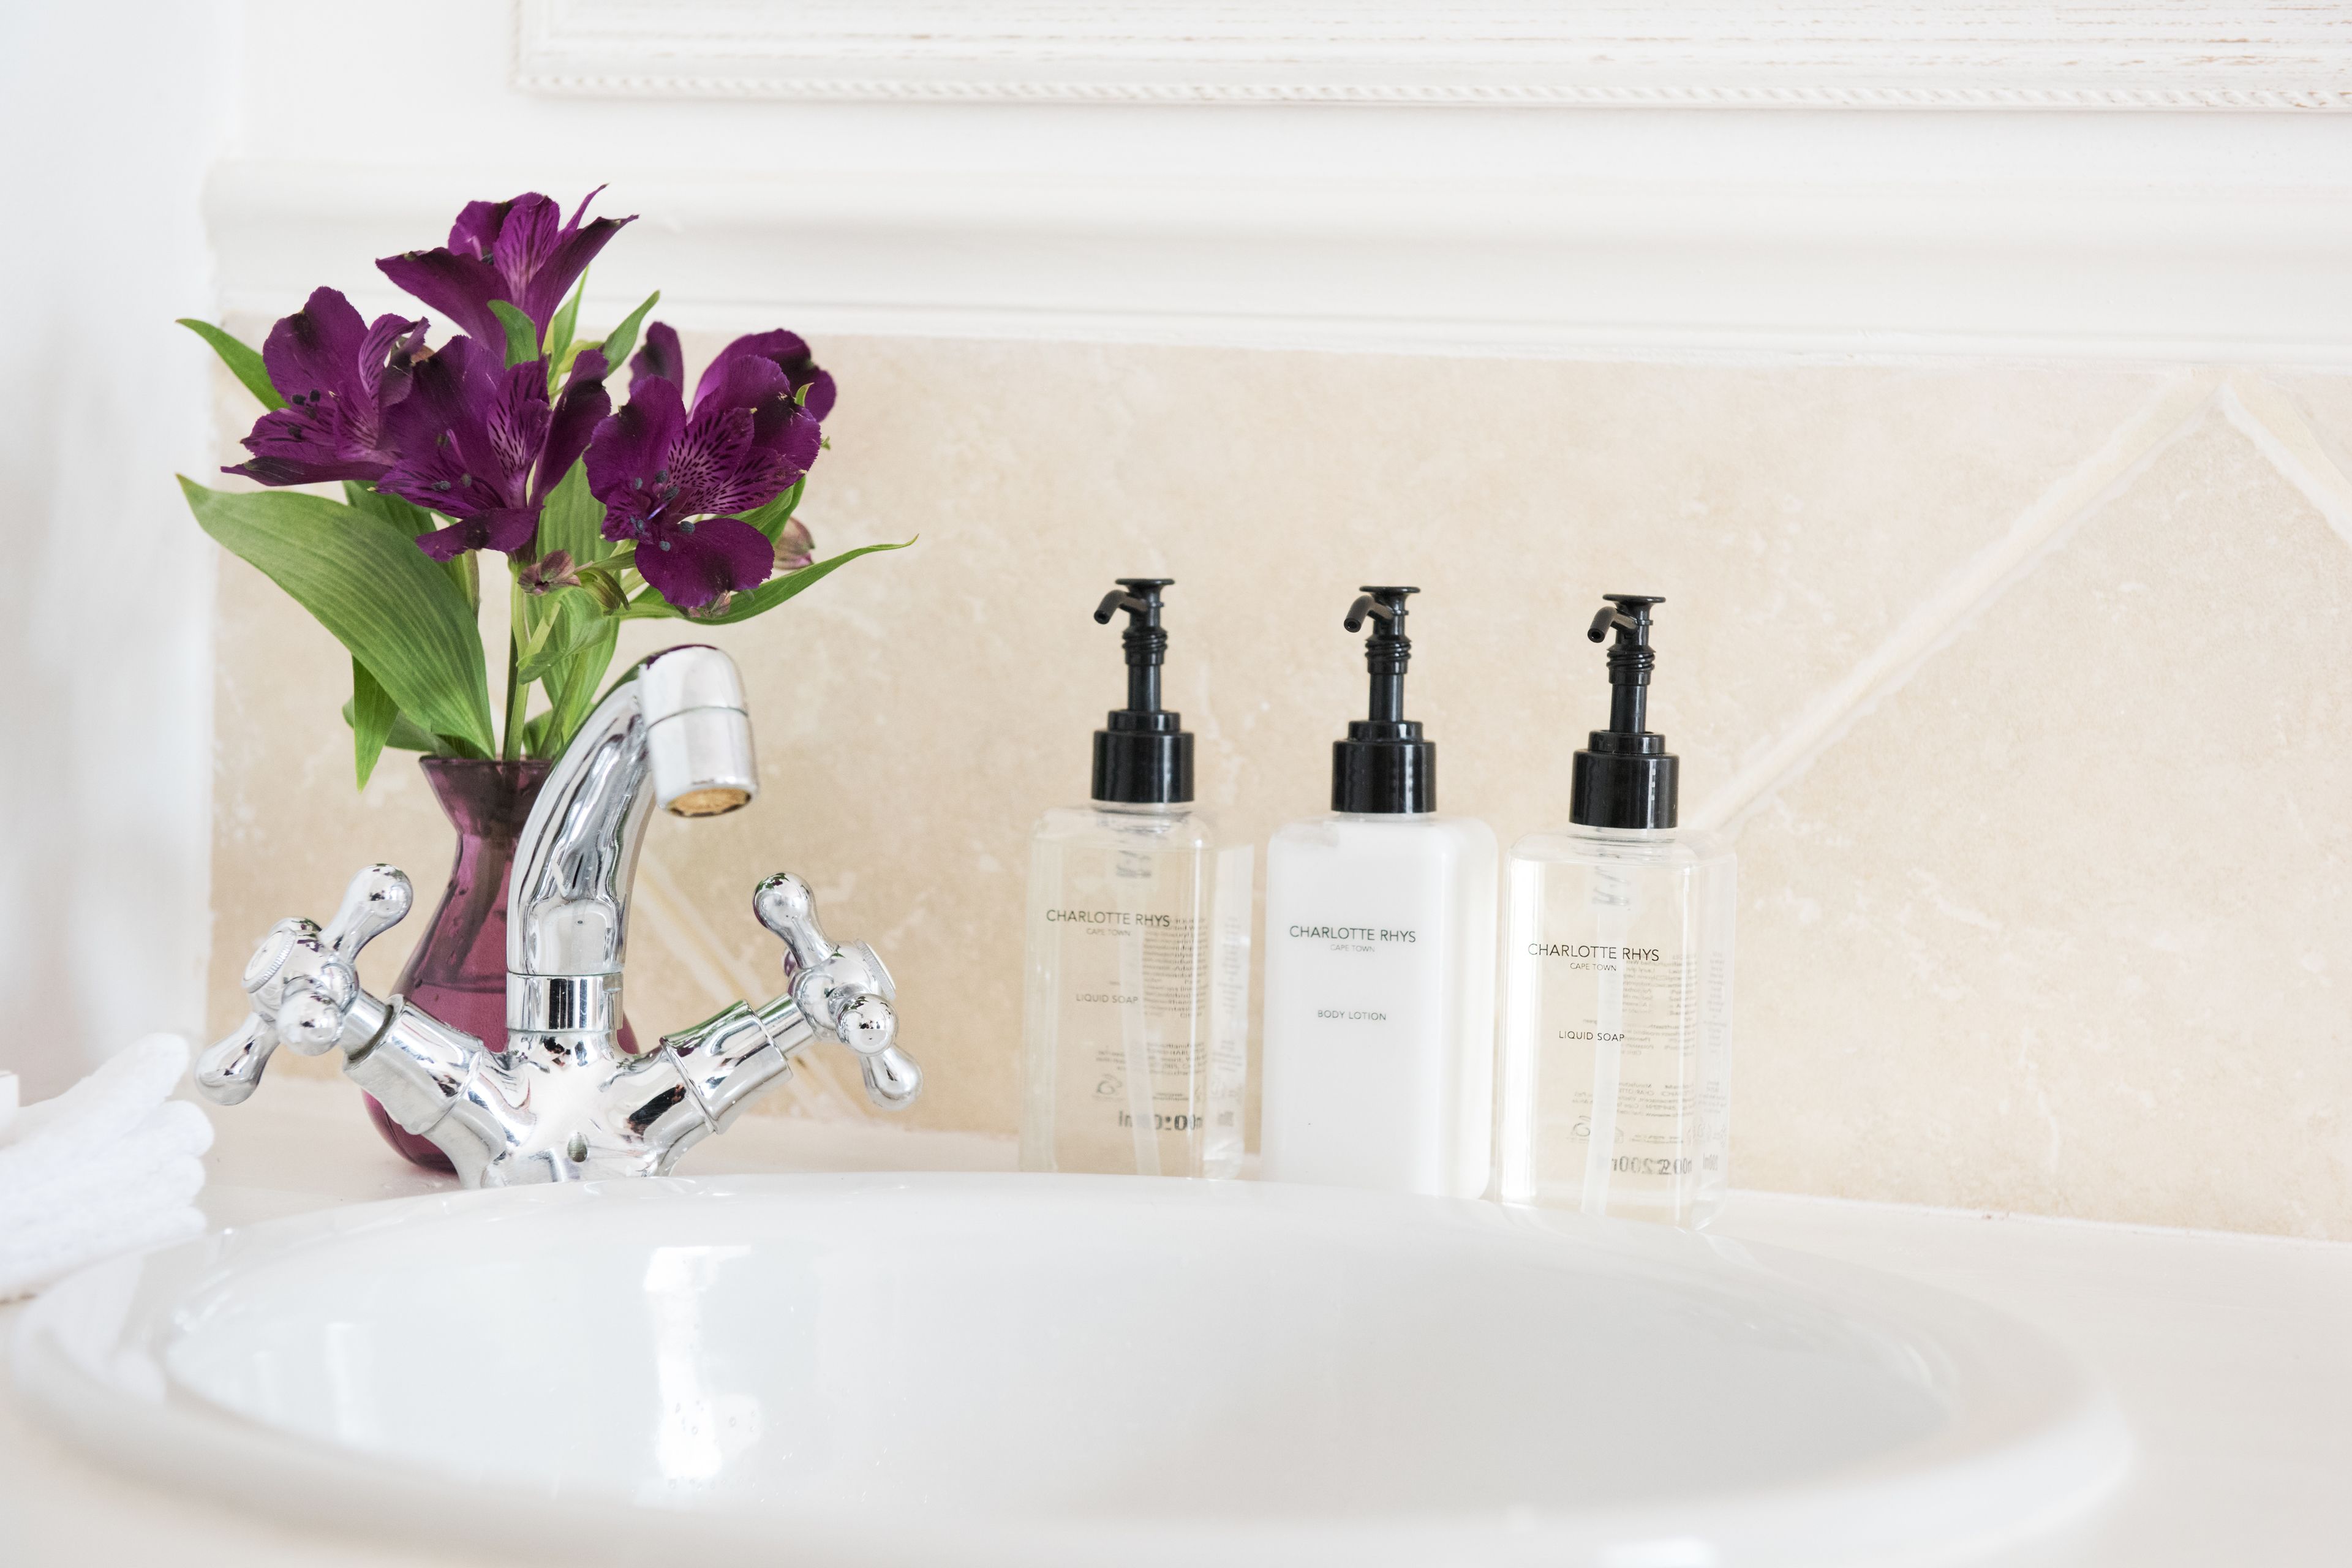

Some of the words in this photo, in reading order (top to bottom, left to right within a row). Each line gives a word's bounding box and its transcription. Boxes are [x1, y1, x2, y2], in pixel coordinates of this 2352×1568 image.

[1046, 909, 1130, 925] CHARLOTTE
[1136, 913, 1170, 928] RHYS
[1086, 927, 1106, 936] CAPE
[1289, 925, 1375, 941] CHARLOTTE
[1380, 929, 1416, 943] RHYS
[1528, 943, 1617, 960] CHARLOTTE
[1623, 948, 1660, 962] RHYS
[1076, 993, 1109, 1003] LIQUID
[1112, 995, 1139, 1005] SOAP
[1317, 1009, 1346, 1019] BODY
[1349, 1011, 1387, 1021] LOTION
[1559, 1031, 1594, 1040] LIQUID
[1597, 1033, 1626, 1042] SOAP
